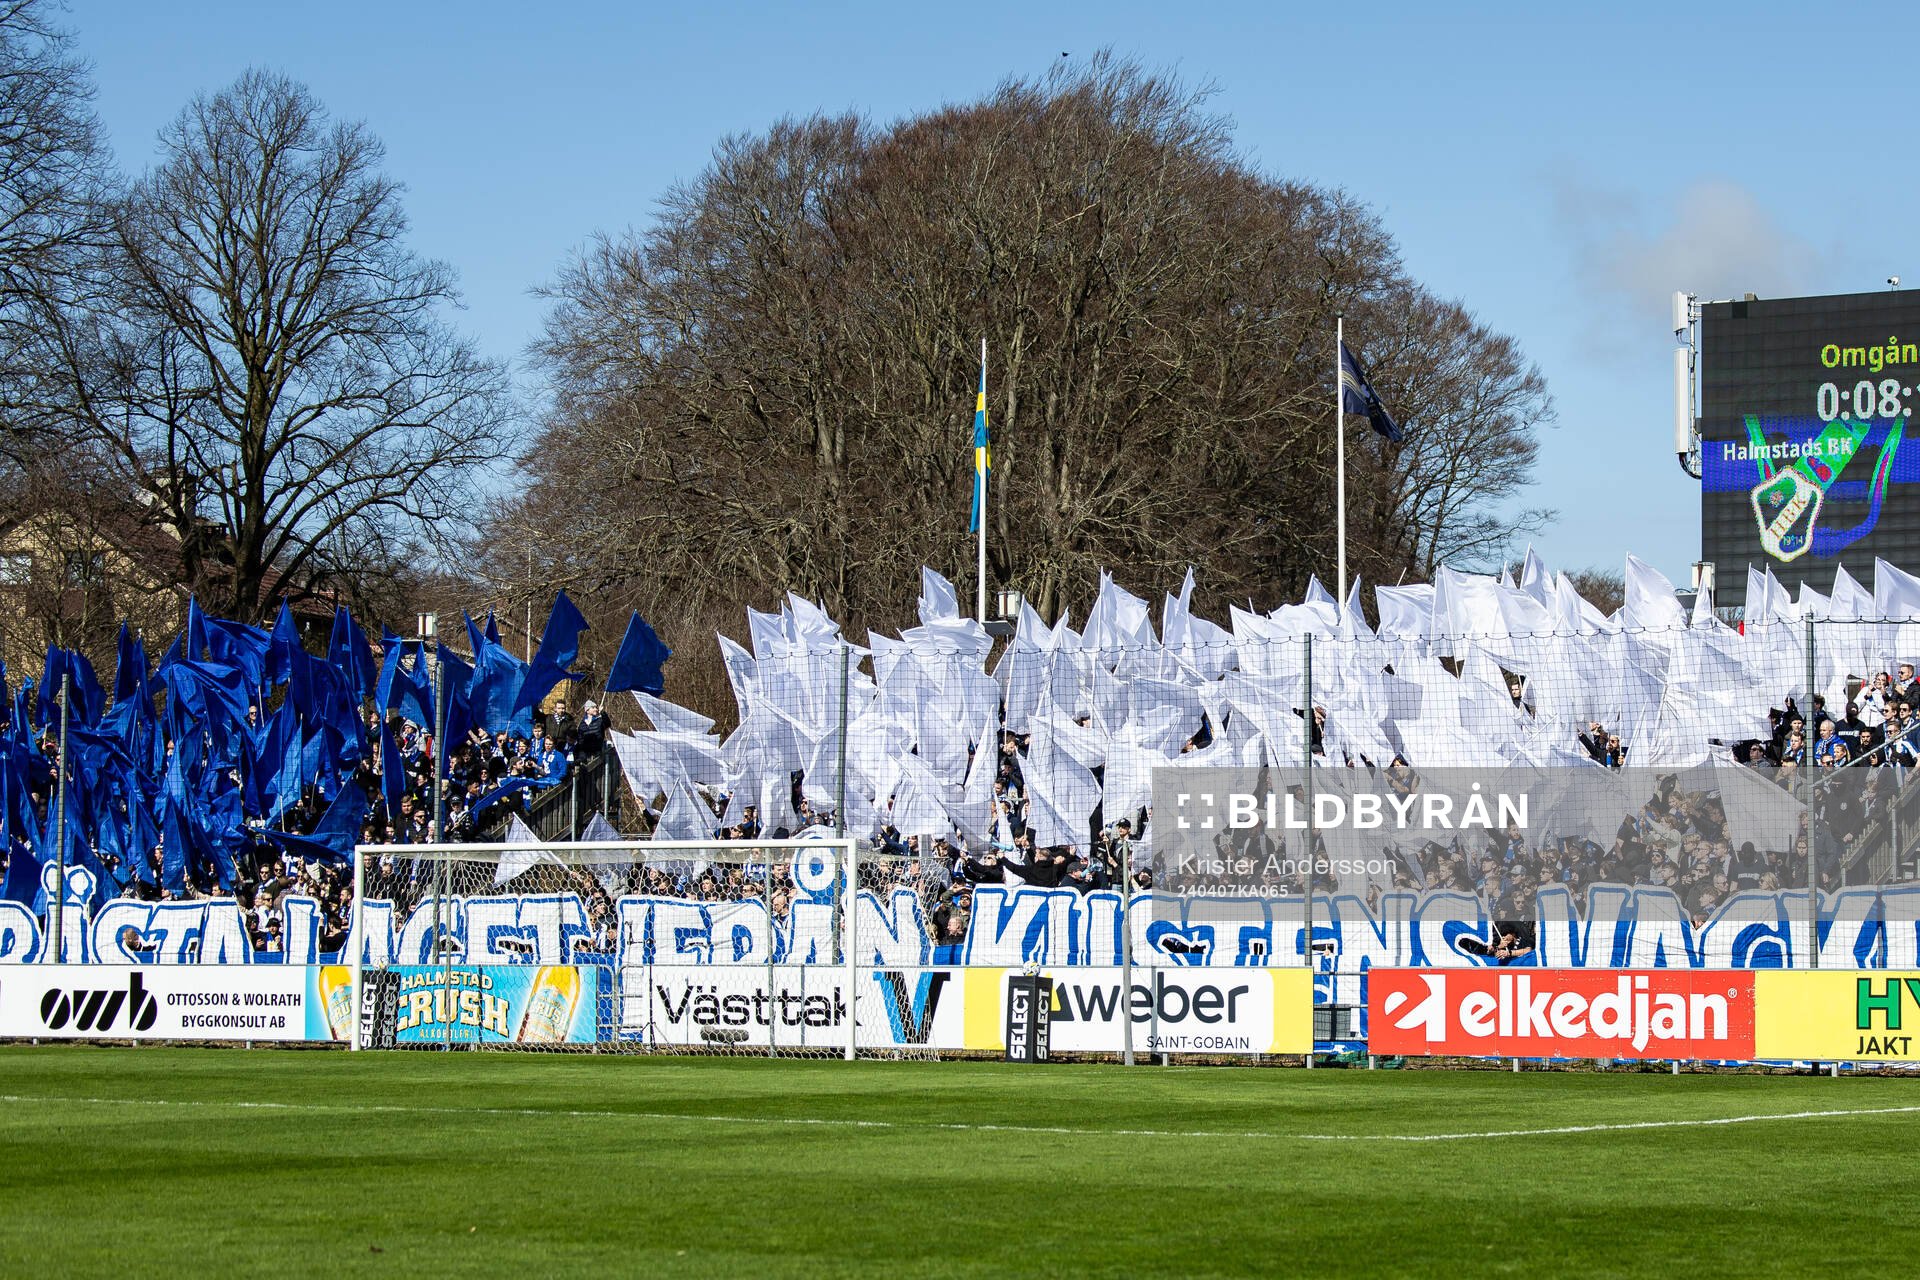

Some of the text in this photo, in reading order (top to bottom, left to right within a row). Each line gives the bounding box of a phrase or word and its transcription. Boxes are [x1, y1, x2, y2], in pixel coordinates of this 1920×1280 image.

[1821, 335, 1920, 373] Omgån
[1724, 437, 1853, 460] Halmstads BK
[402, 971, 492, 990] HALMSTAD
[167, 993, 301, 1007] OTTOSSON & WOLRATH
[656, 985, 863, 1027] Västtak
[1073, 971, 1249, 1024] weber
[182, 1015, 286, 1028] BYGGKONSULT AB
[360, 981, 377, 1048] SELECT
[1010, 988, 1030, 1059] SELECT
[1036, 989, 1050, 1060] SELECT
[1146, 1035, 1250, 1050] SAINT-GOBAIN
[1856, 1035, 1913, 1056] JAKT
